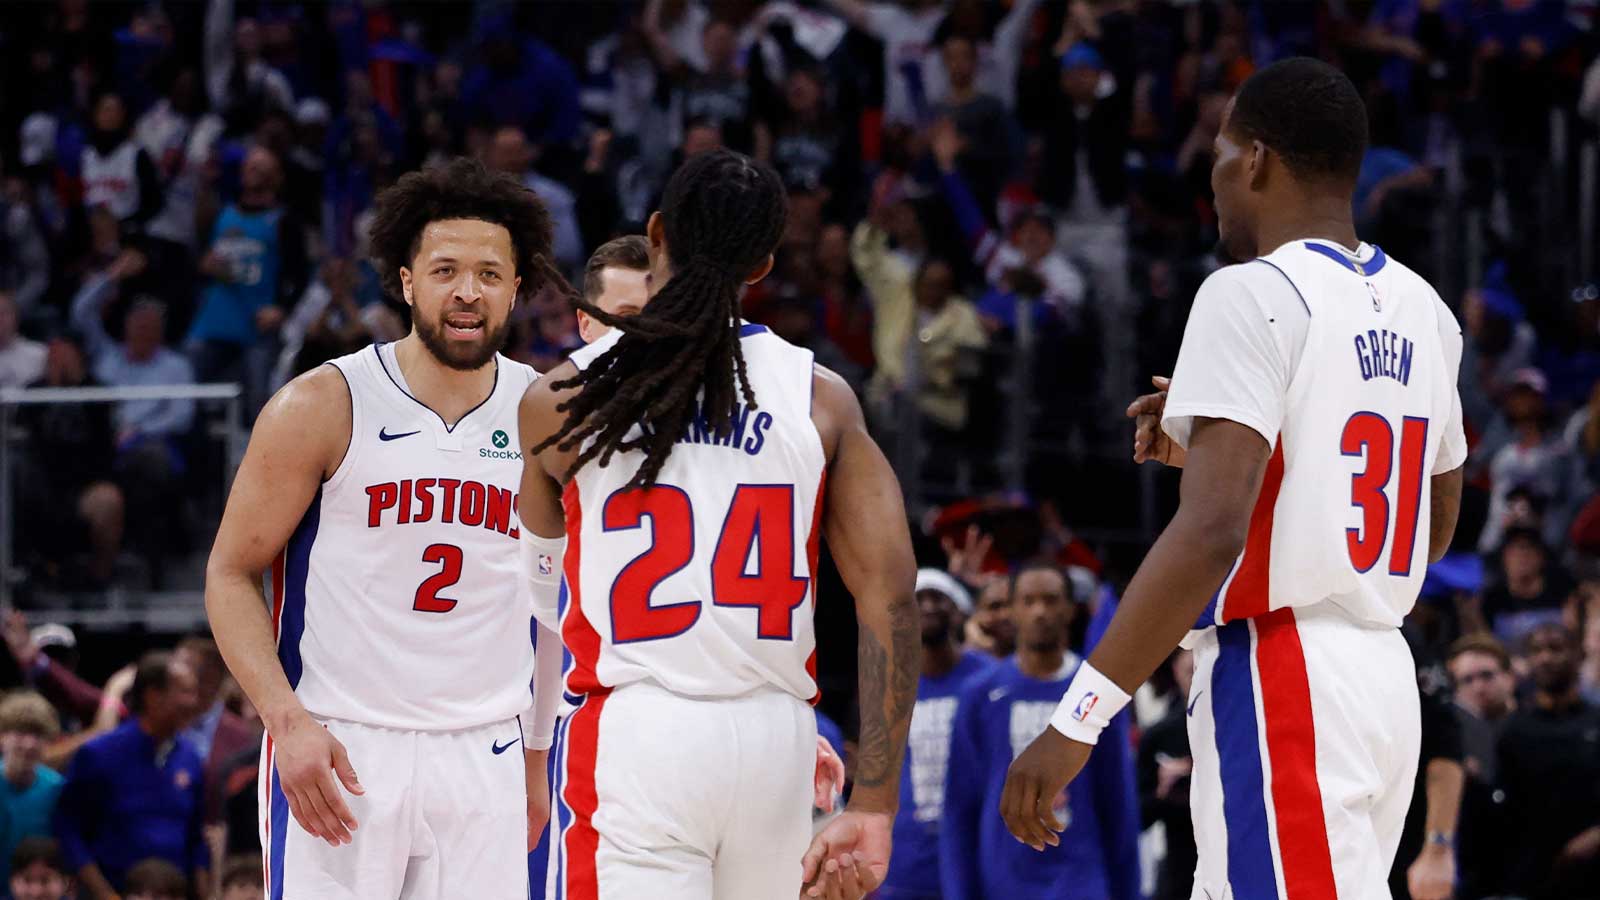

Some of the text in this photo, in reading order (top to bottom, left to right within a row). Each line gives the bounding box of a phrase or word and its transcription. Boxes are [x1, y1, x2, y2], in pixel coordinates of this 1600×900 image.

[1354, 329, 1413, 387] GREEN
[479, 448, 522, 460] StockX
[1340, 411, 1429, 577] 31
[413, 543, 463, 613] 2
[602, 483, 810, 645] 24
